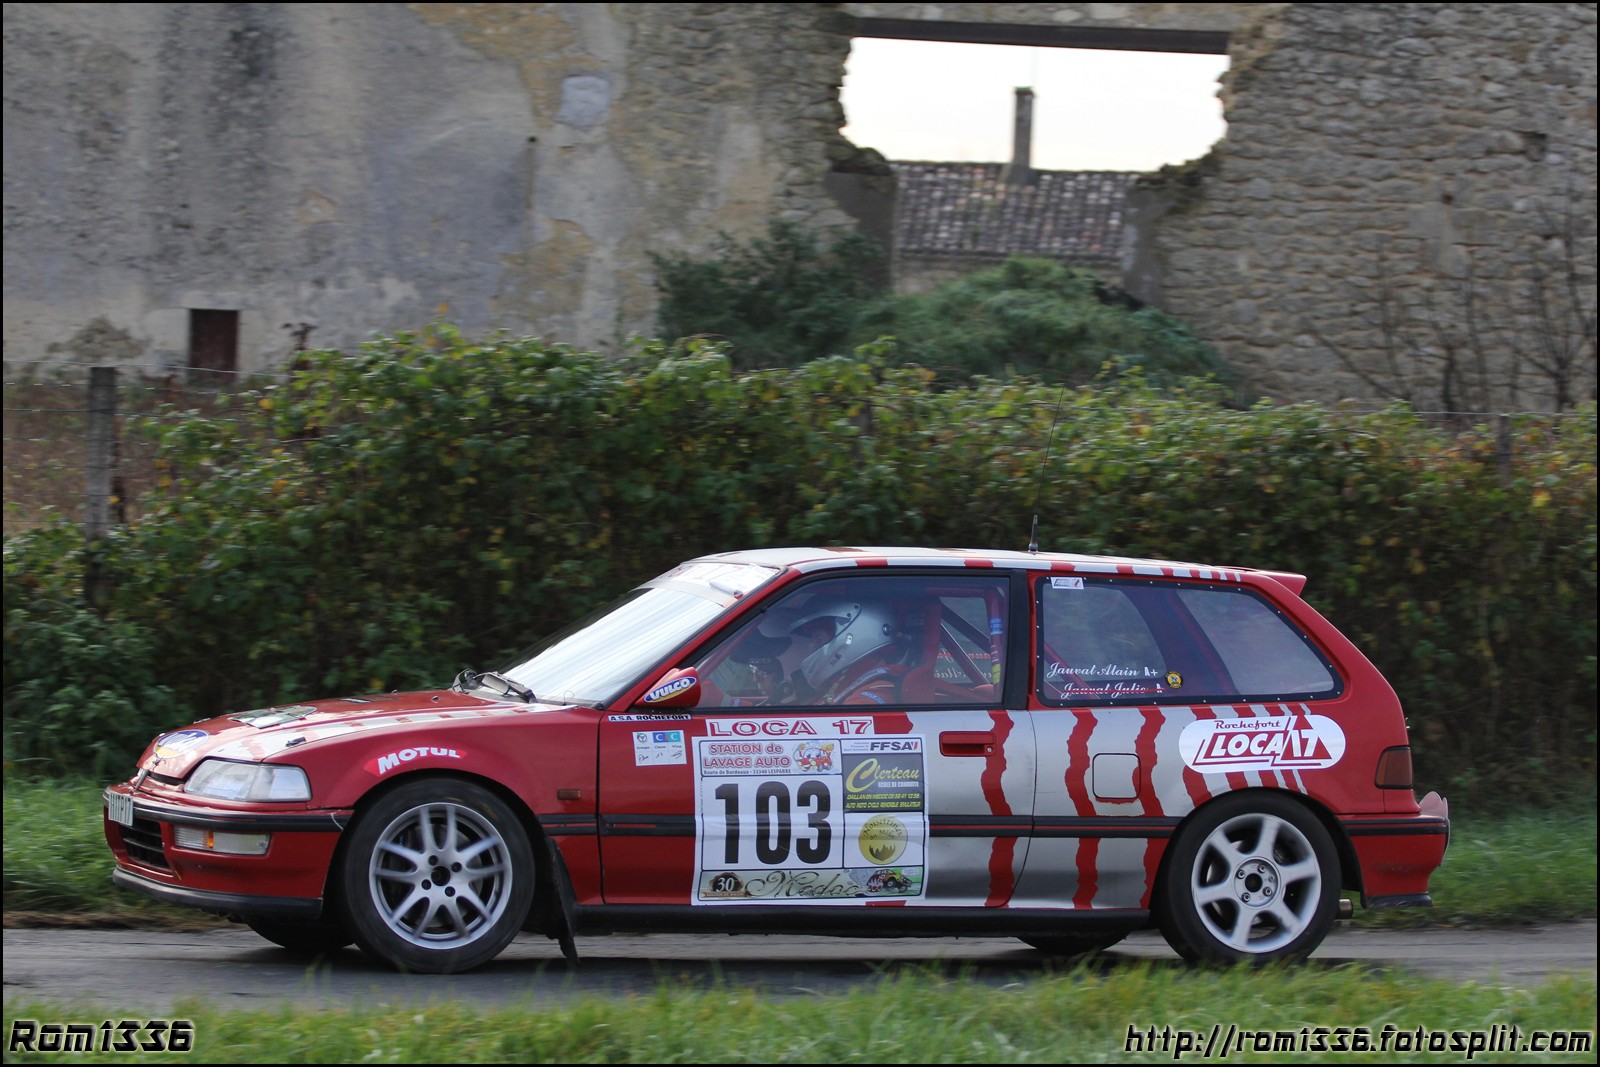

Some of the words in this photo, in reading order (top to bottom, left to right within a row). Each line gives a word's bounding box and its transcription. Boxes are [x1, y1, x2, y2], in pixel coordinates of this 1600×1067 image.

[1097, 664, 1140, 677] Alain
[649, 678, 691, 701] VULCO
[709, 720, 816, 736] LOCA
[833, 719, 872, 734] 17
[1214, 720, 1281, 730] Rochefort
[655, 733, 680, 741] CIC
[709, 743, 762, 754] STATION
[766, 742, 783, 753] de
[870, 741, 913, 751] FFSA
[378, 747, 461, 774] MOTUL
[704, 757, 751, 768] LAVAGE
[755, 757, 791, 767] AUTO
[846, 757, 920, 793] Clerteau
[715, 780, 831, 864] 103
[716, 877, 735, 892] 30
